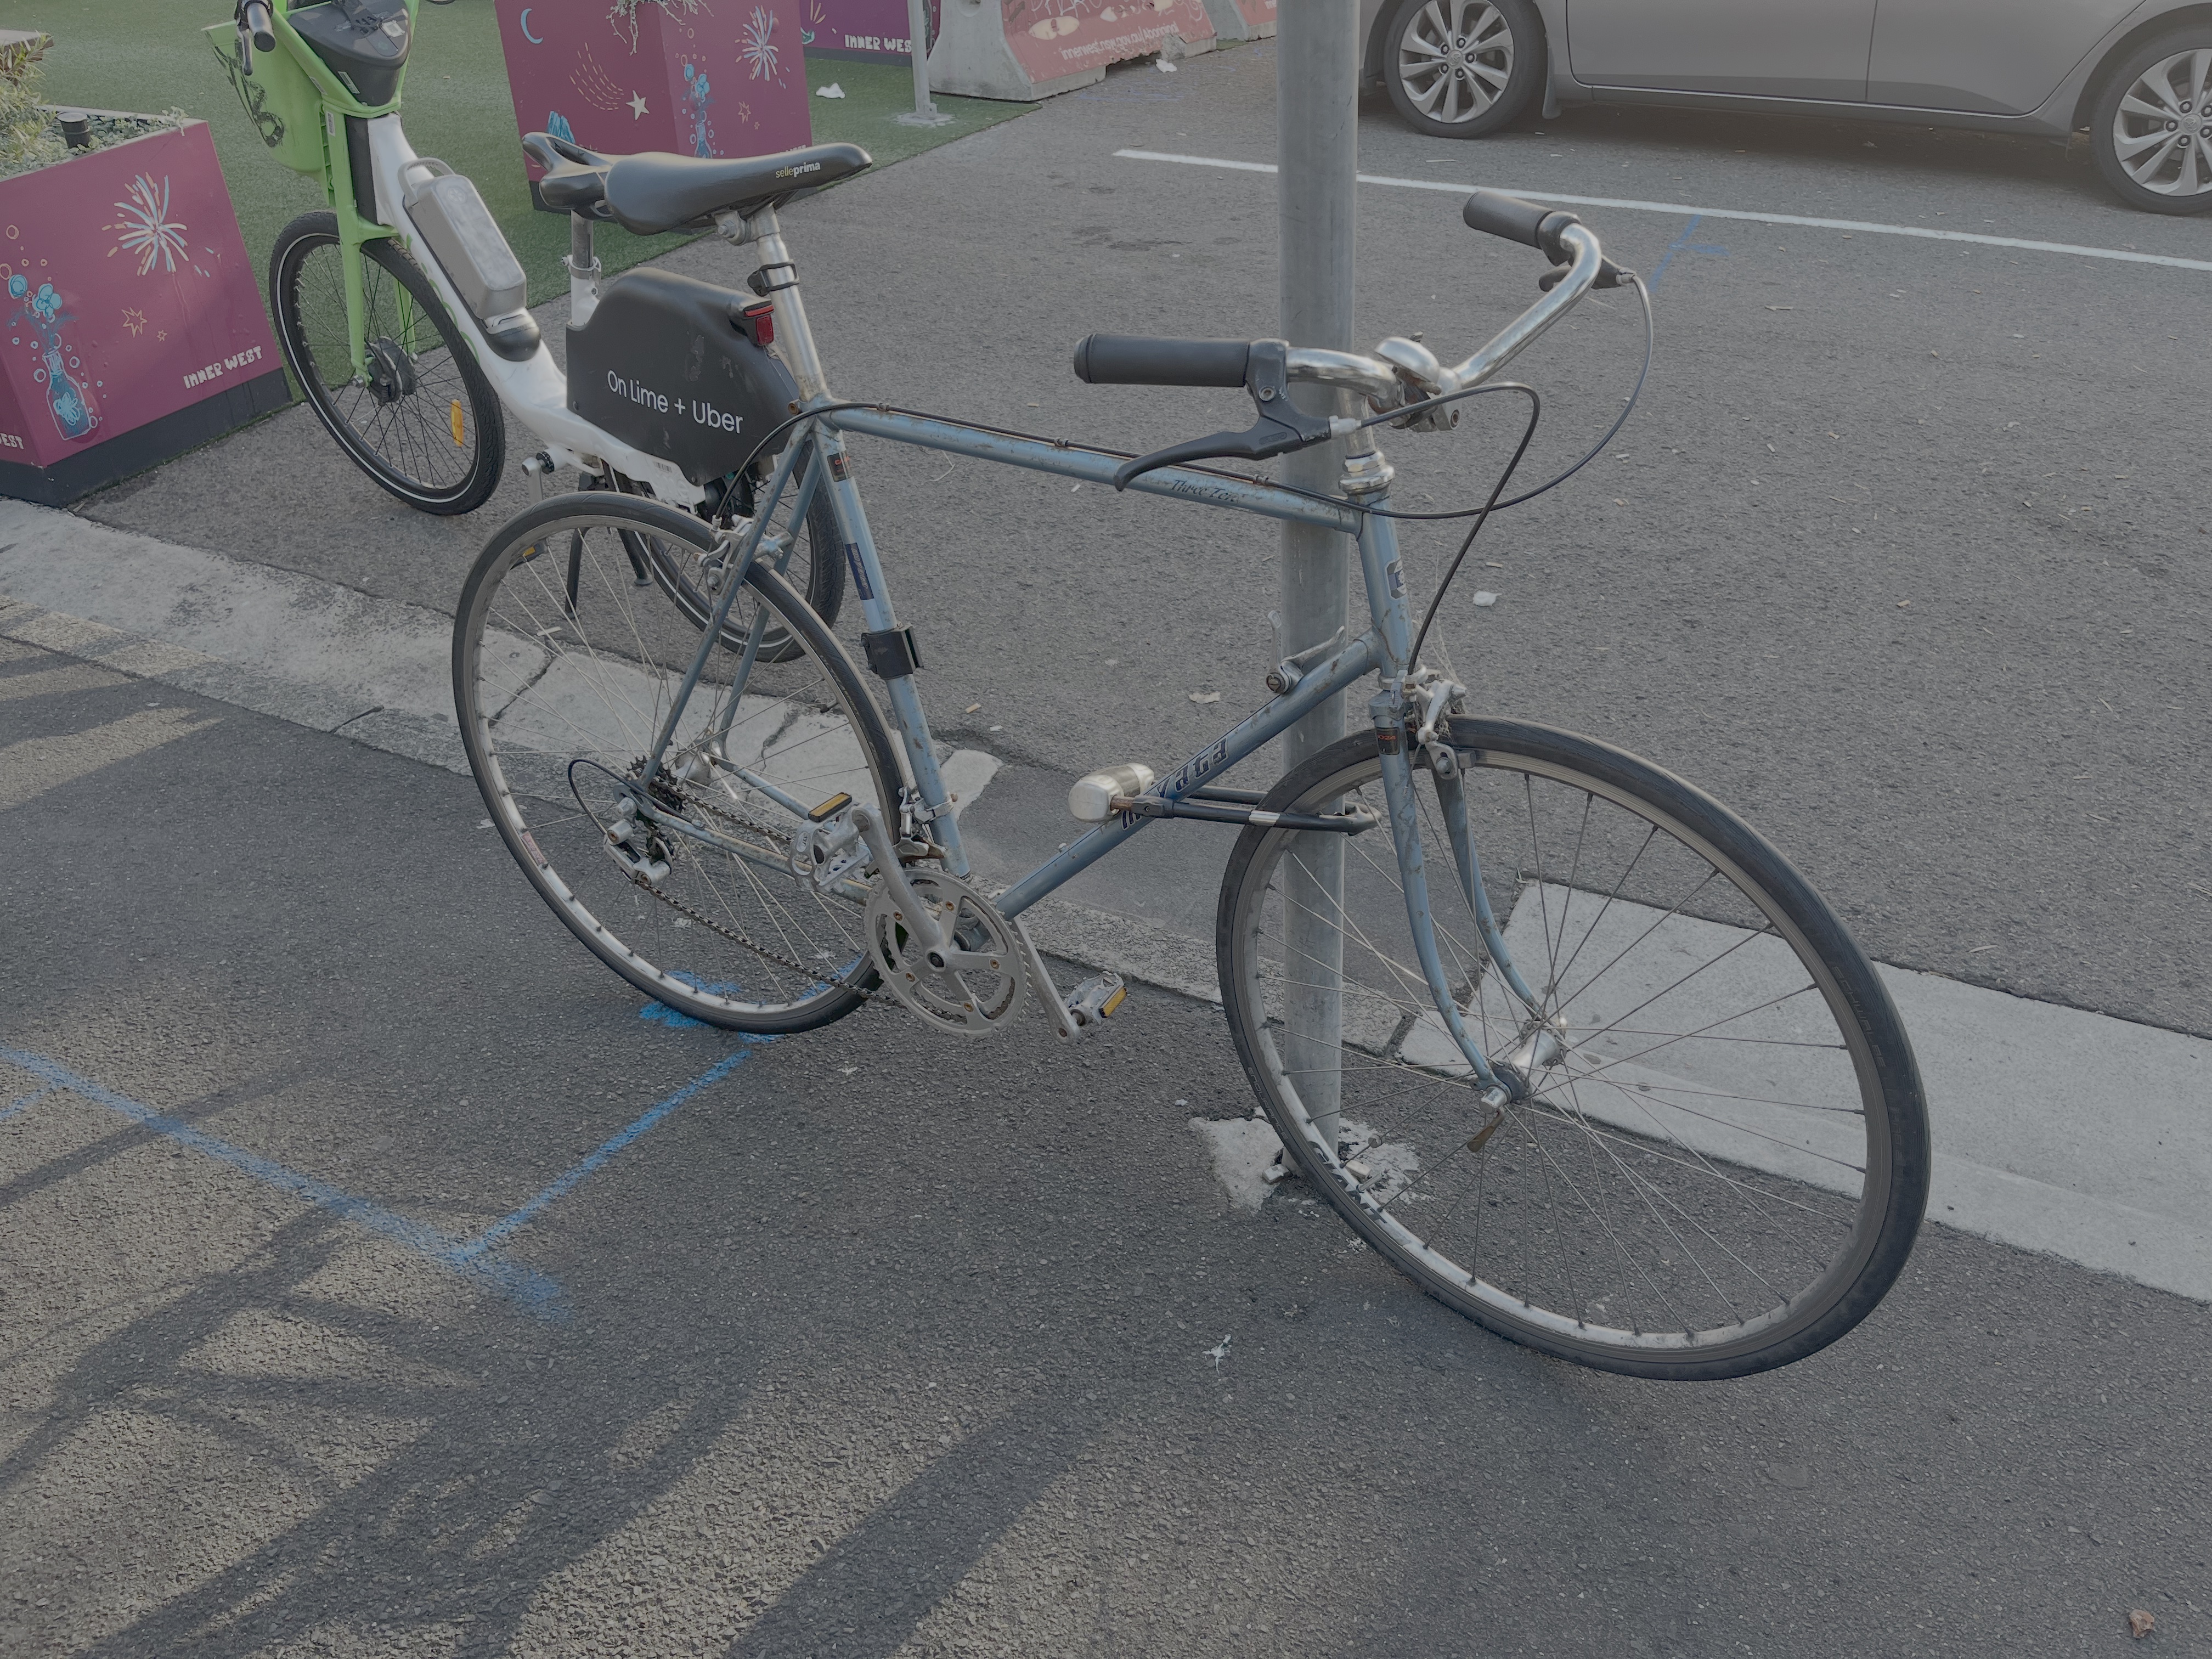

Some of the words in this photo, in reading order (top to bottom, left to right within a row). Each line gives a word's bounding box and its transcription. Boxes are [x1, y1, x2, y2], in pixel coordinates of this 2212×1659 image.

[845, 34, 881, 50] INNER
[883, 37, 911, 53] WES
[183, 362, 223, 389] INNER
[224, 345, 263, 371] WEST
[607, 370, 627, 398] On
[630, 379, 668, 413] Lime
[674, 398, 686, 415] +
[692, 399, 743, 434] Uber
[1246, 1066, 1289, 1140] ENDURANCE
[1307, 1141, 1388, 1224] GIANT
